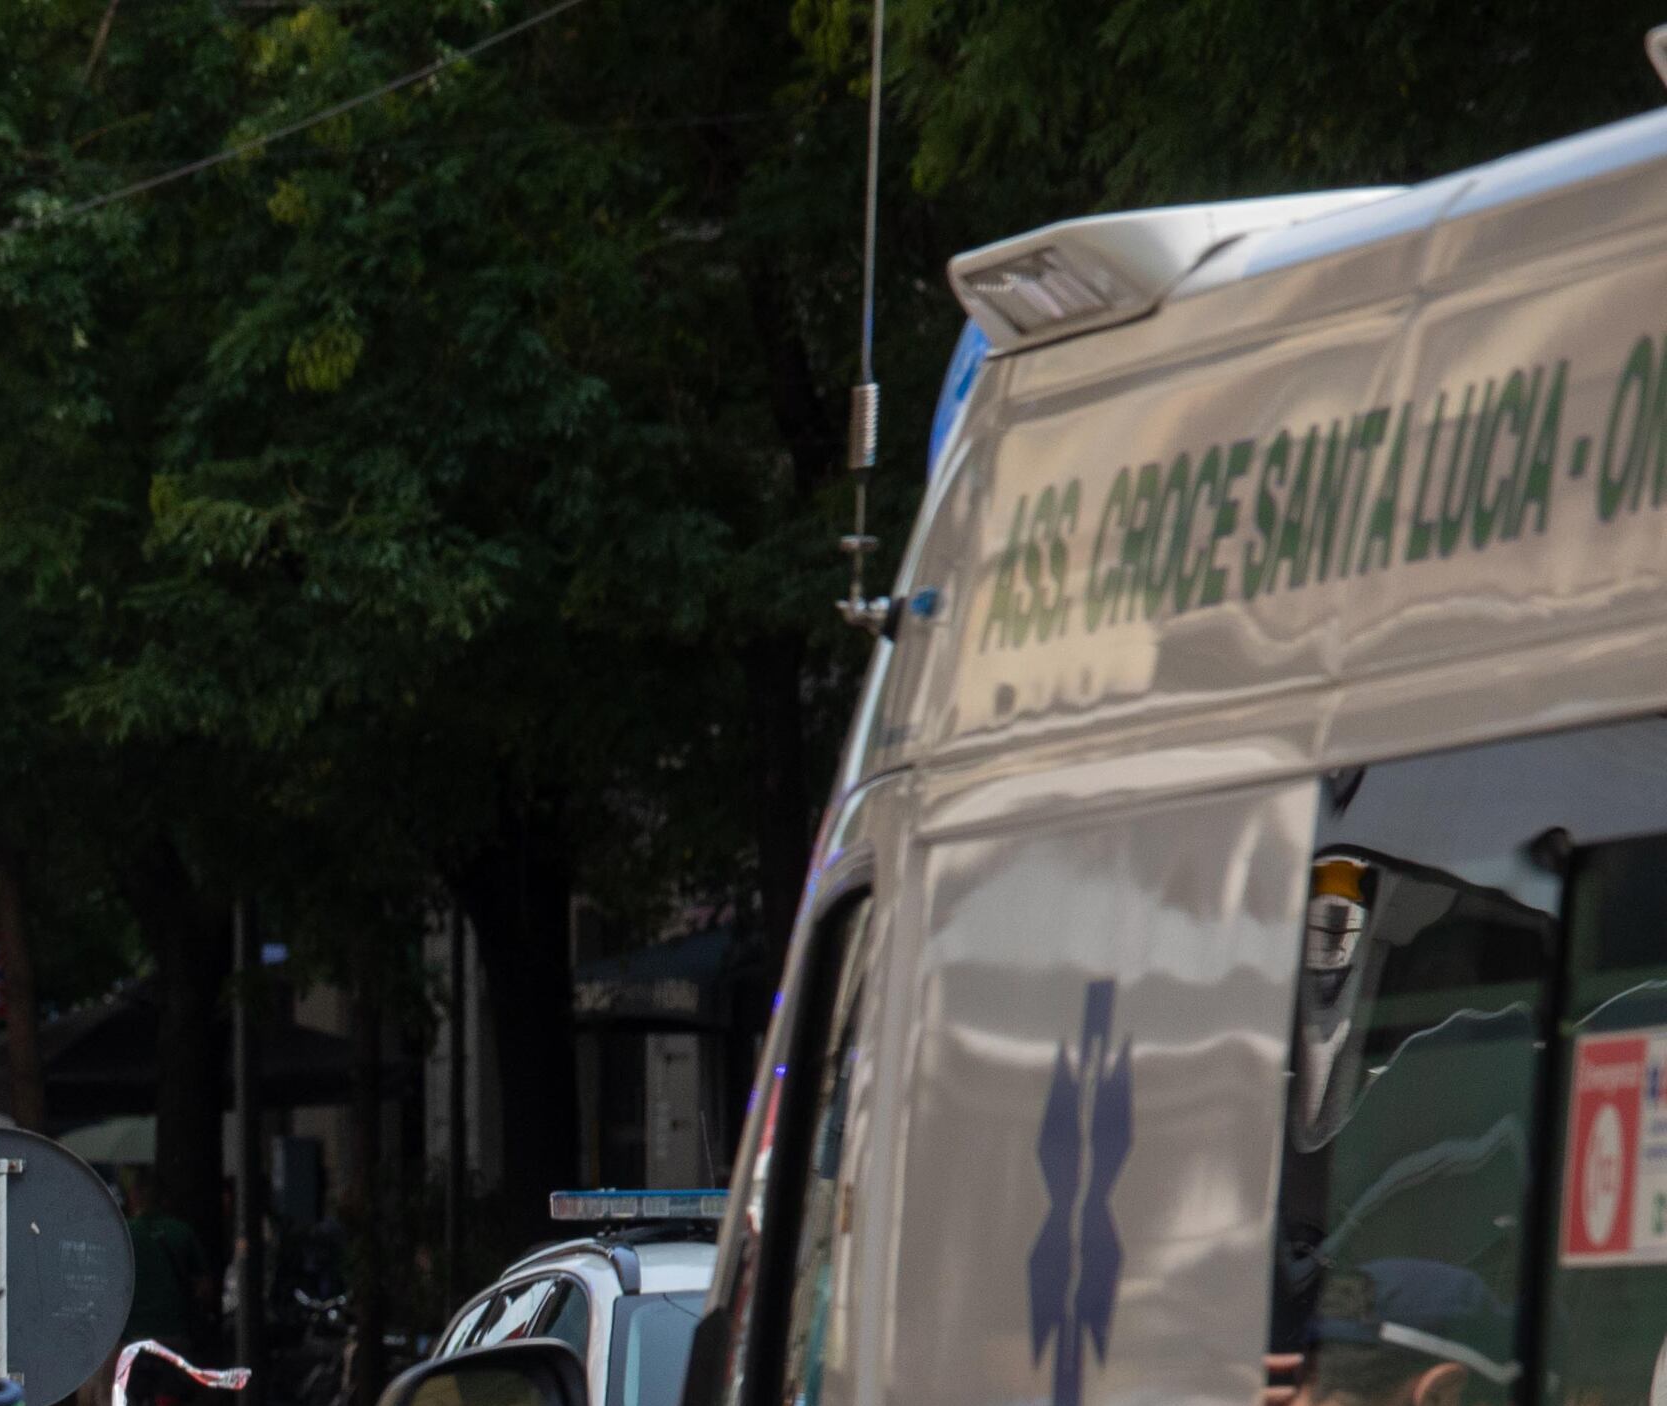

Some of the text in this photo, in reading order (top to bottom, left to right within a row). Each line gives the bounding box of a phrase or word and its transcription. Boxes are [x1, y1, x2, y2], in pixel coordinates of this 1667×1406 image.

[979, 479, 1080, 652] ASS.
[1085, 439, 1257, 634] CROCE
[1242, 402, 1411, 600] SANTA
[1405, 359, 1571, 560] LUCIA
